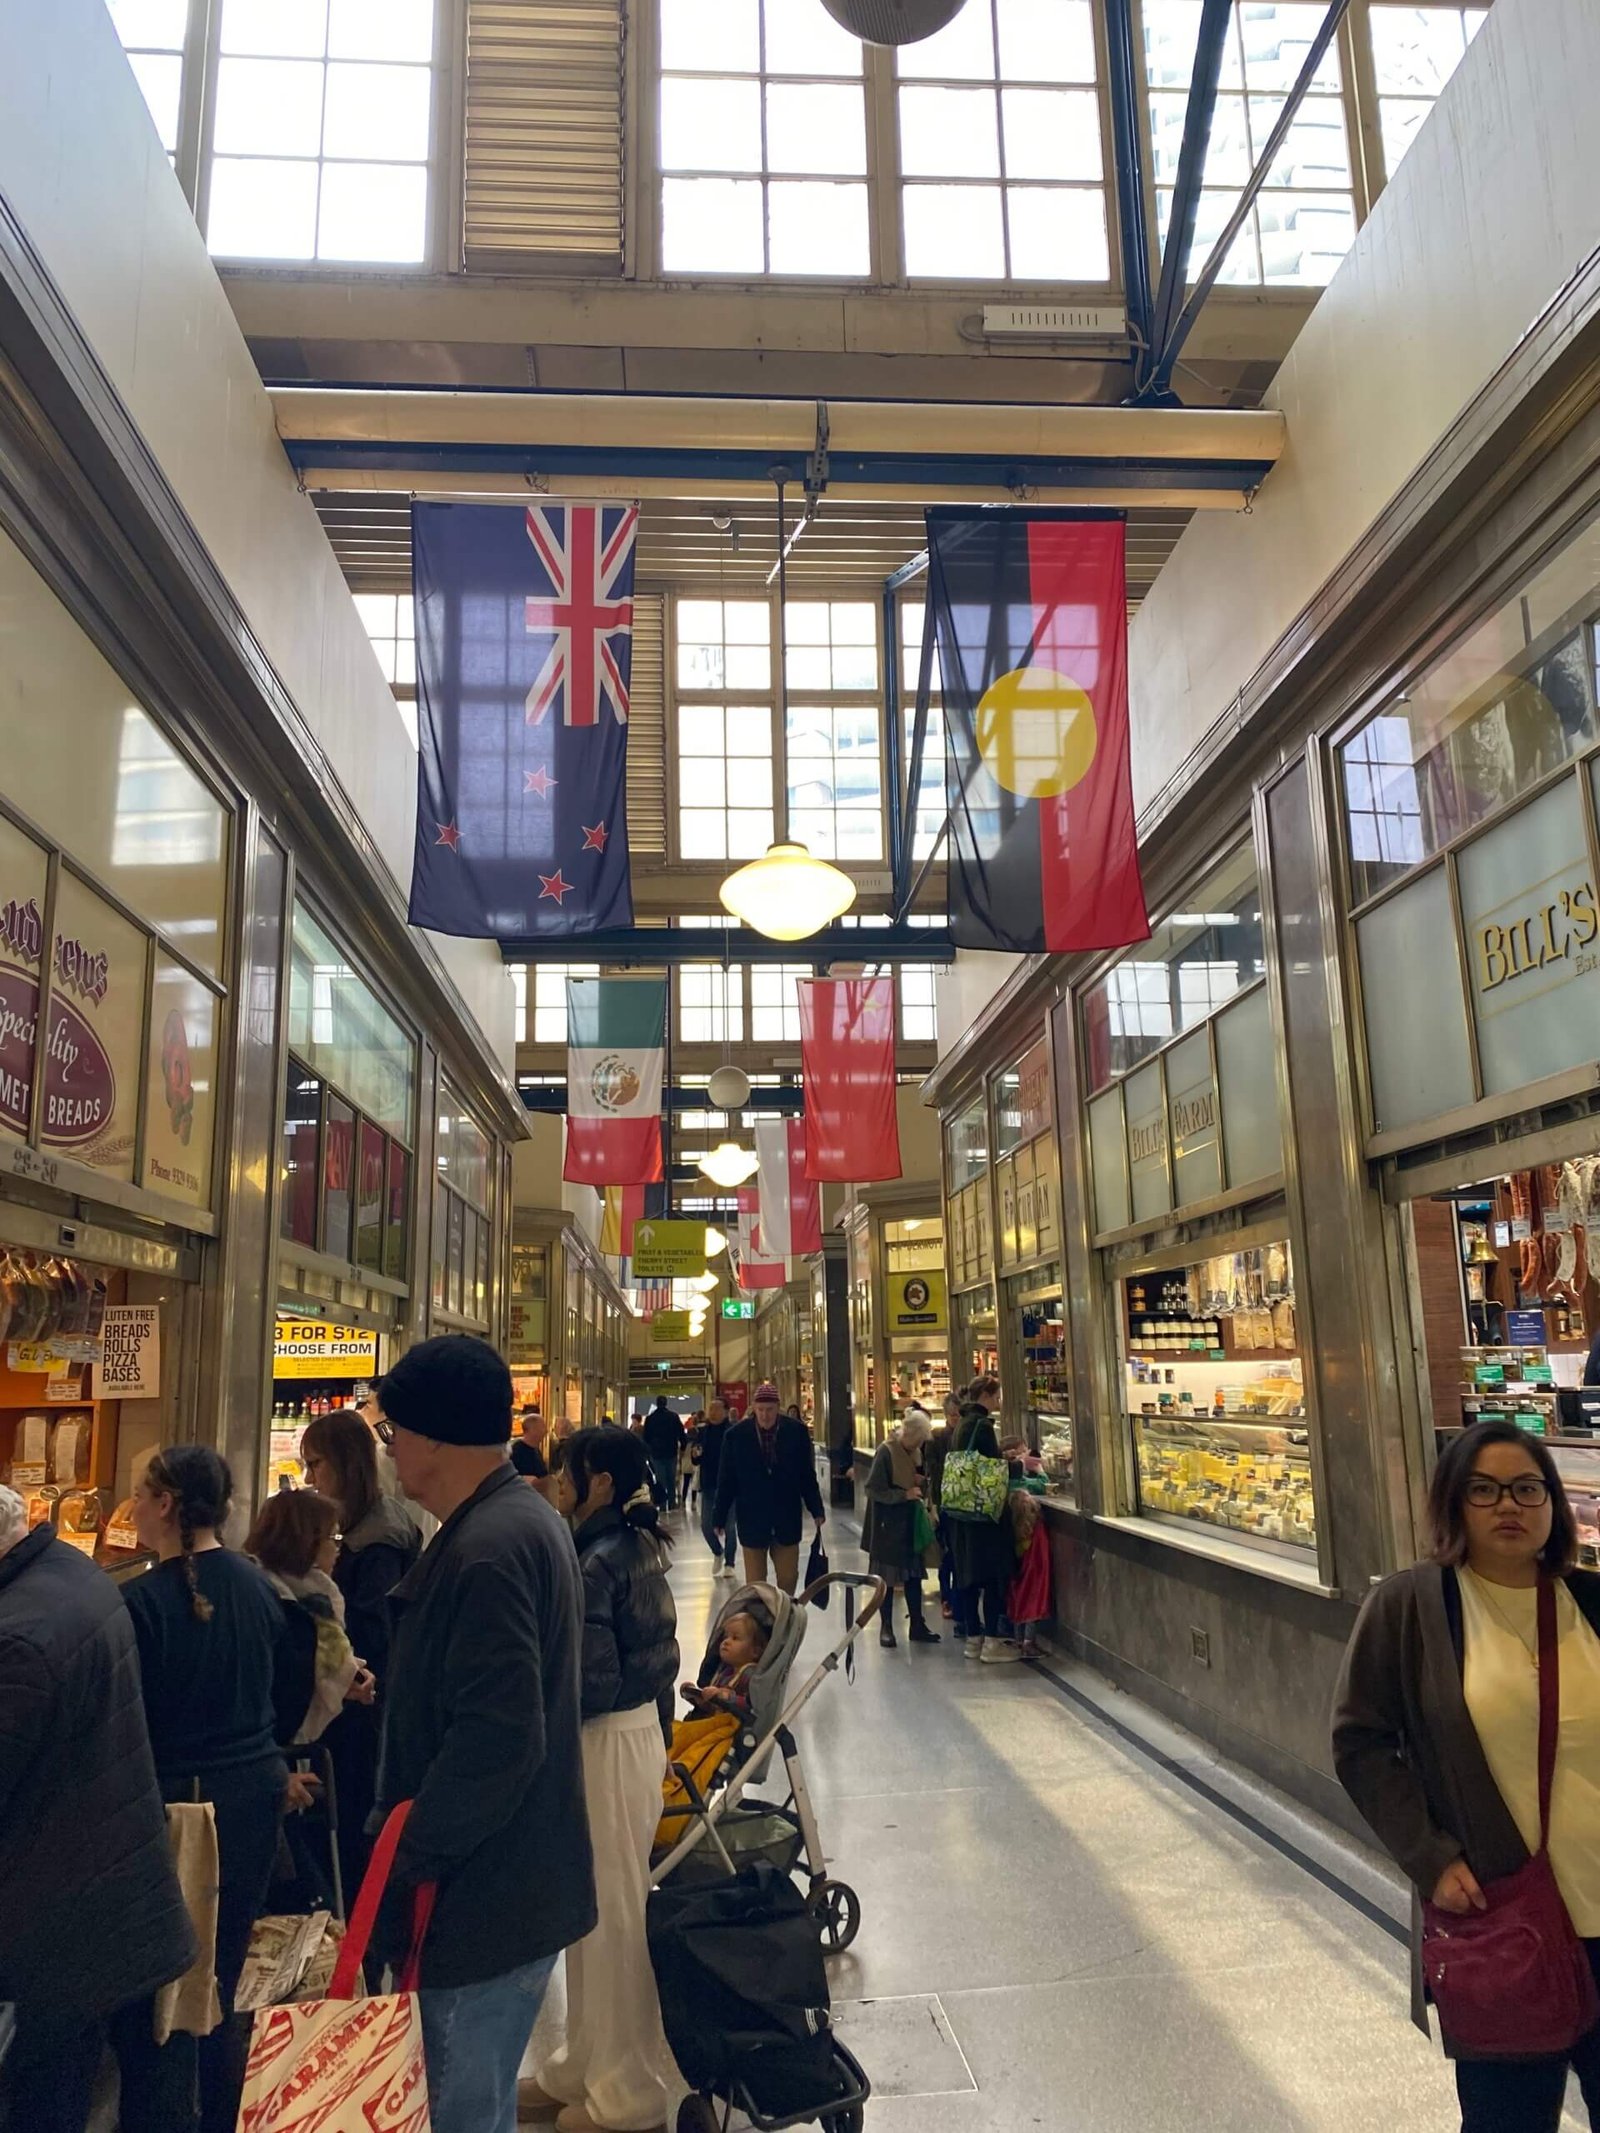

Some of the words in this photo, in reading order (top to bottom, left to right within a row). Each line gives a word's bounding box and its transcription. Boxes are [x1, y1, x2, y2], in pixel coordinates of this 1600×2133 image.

[1477, 882, 1598, 992] BILL'S
[48, 1094, 100, 1127] BREADS
[1174, 1092, 1216, 1138] FARM
[104, 1309, 133, 1322] LUTEN
[135, 1309, 156, 1321] FREE
[104, 1323, 150, 1339] BREADS
[291, 1326, 327, 1340] FOR
[103, 1338, 141, 1353] ROLLS
[331, 1343, 372, 1354] FROM
[103, 1353, 137, 1367] PIZZA
[103, 1367, 141, 1383] BASES
[266, 2000, 389, 2125] CARAMEL
